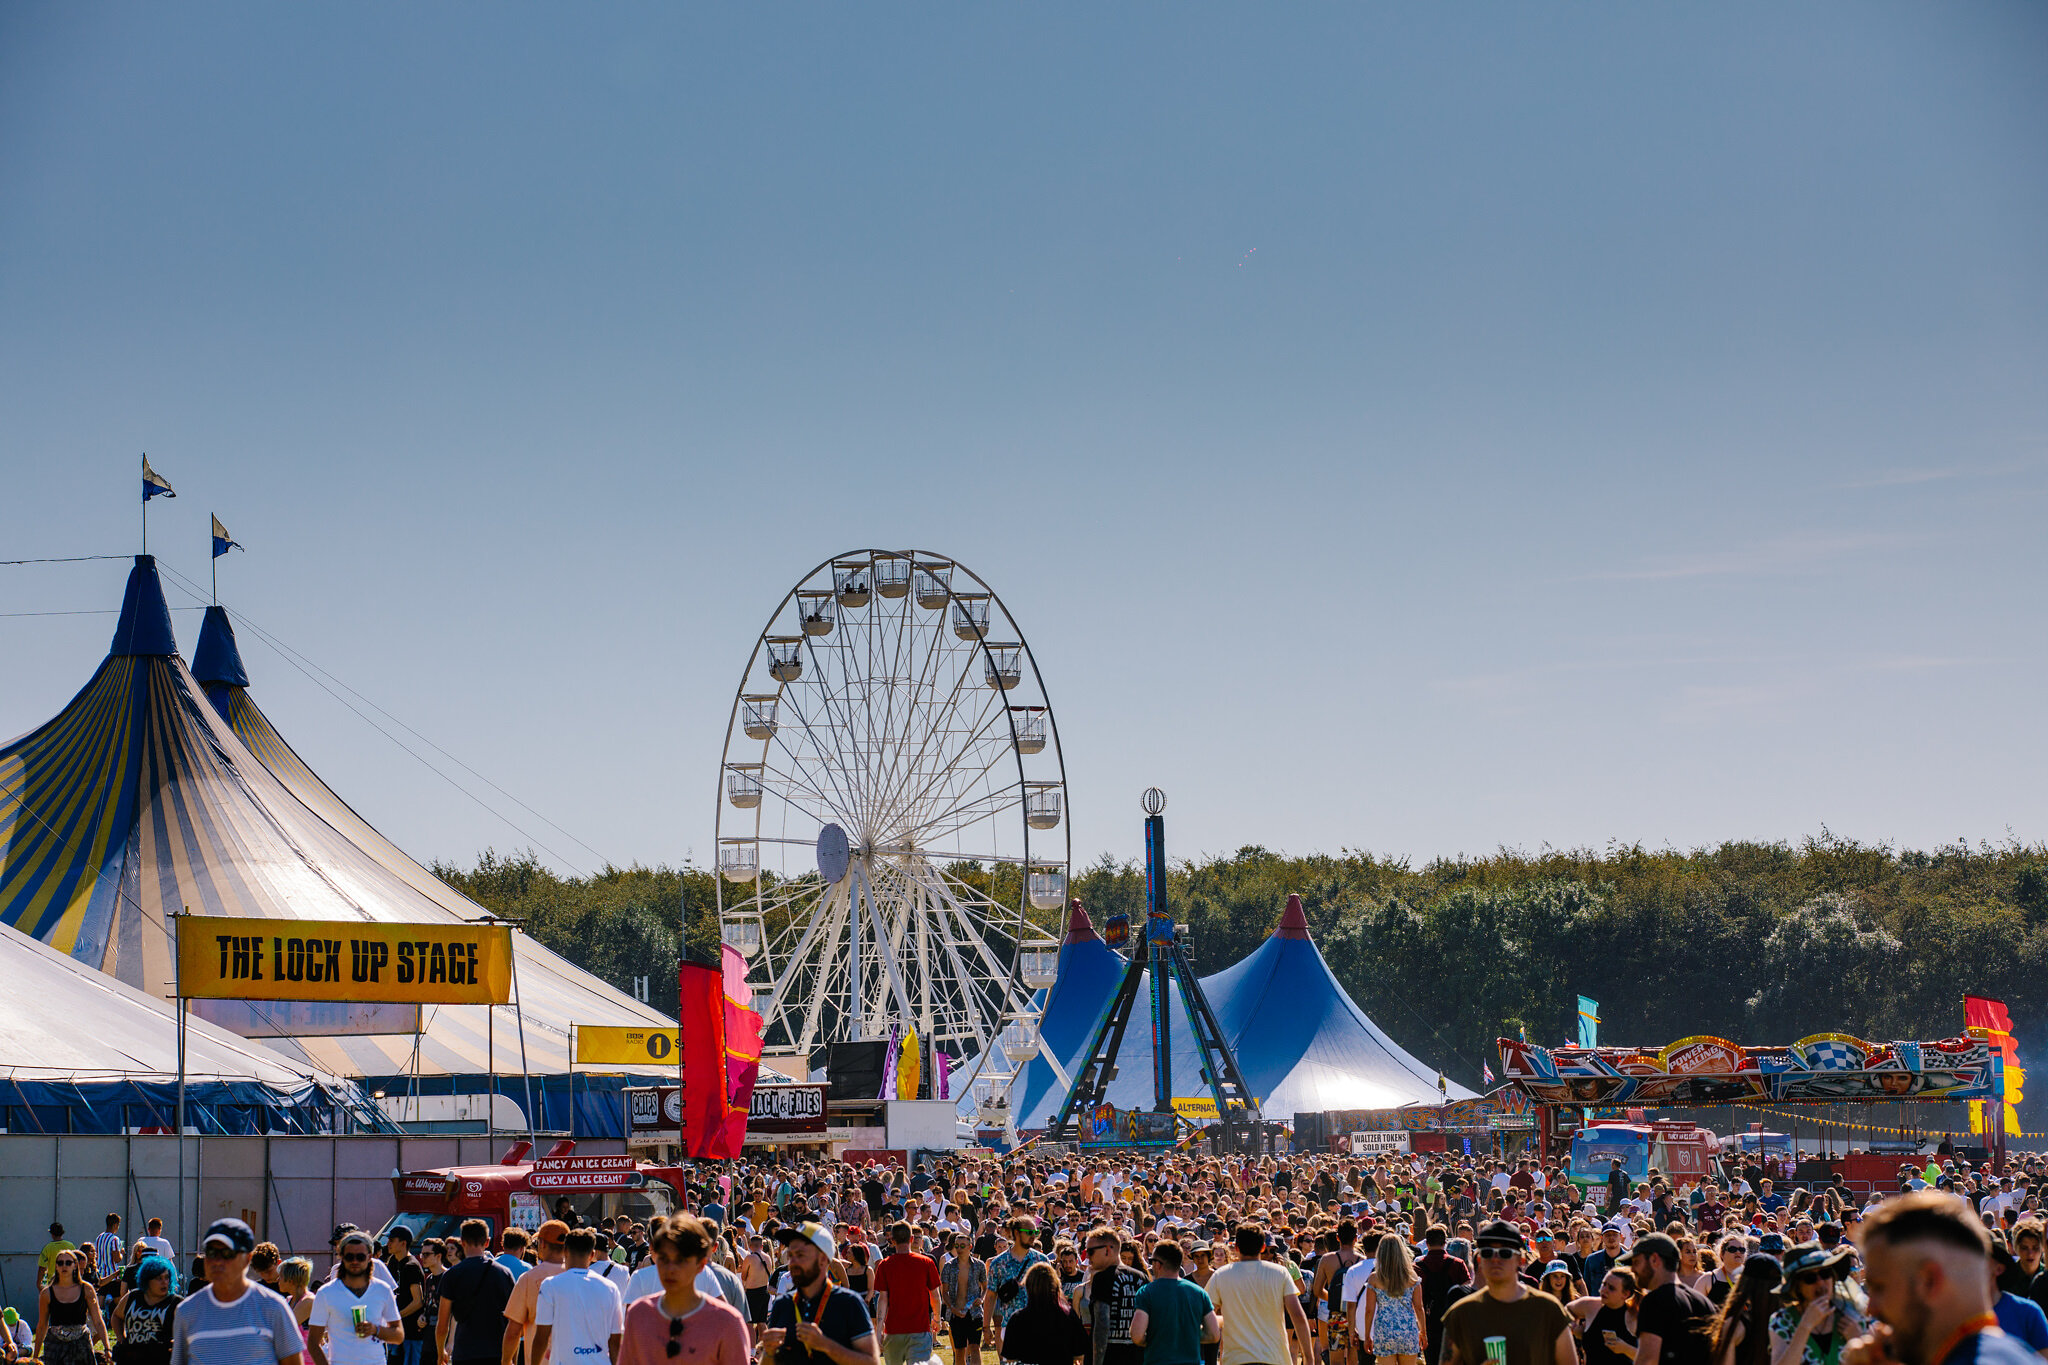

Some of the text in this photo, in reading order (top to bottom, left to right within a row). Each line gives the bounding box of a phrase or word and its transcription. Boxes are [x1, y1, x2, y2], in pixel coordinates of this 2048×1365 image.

[216, 935, 478, 984] THE LOCK UP STAGE
[1669, 1044, 1704, 1070] POWER
[1681, 1045, 1718, 1072] RACING
[633, 1094, 657, 1116] CHIPS
[780, 1095, 788, 1113] &
[788, 1090, 821, 1115] FRIES
[1177, 1103, 1220, 1113] ALTERNAT
[1354, 1133, 1407, 1143] WALTZER TOKENS
[1362, 1143, 1397, 1151] SOLD HERE
[536, 1158, 633, 1170] FANCY AN ICE CREAM?
[415, 1178, 446, 1192] Whippy
[535, 1174, 623, 1186] FANCY AN ICE CREAM?
[125, 1300, 171, 1325] NOW
[127, 1318, 162, 1333] LOSE
